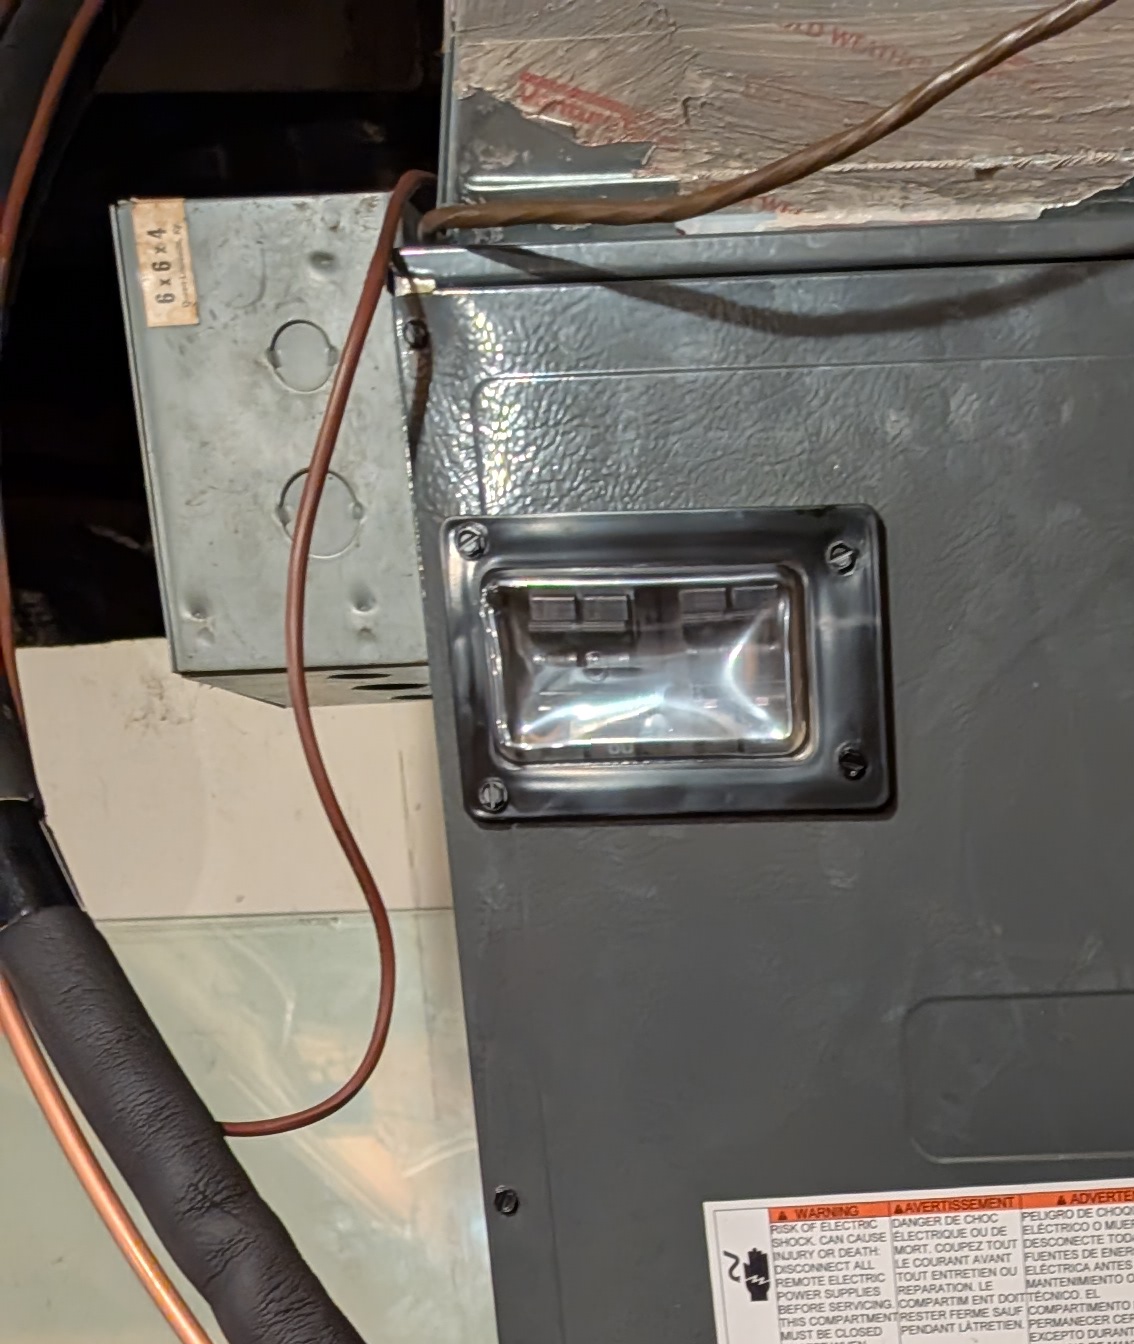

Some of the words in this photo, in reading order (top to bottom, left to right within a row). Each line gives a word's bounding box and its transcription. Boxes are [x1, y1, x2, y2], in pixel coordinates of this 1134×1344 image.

[147, 228, 167, 239] 4
[151, 261, 172, 272] 6
[155, 293, 176, 304] 6
[794, 1205, 860, 1218] WARNING
[904, 1197, 1016, 1213] AVERTISSEMENT
[769, 1224, 798, 1233] RISK
[800, 1223, 816, 1232] OF
[820, 1220, 877, 1231] ELECTRIC
[819, 1235, 844, 1245] CAN
[846, 1233, 886, 1243] CAUSE
[772, 1250, 815, 1260] INJURY
[817, 1249, 835, 1258] OR
[773, 1262, 850, 1273] DISCONNECT
[853, 1261, 875, 1271] ALL
[774, 1276, 825, 1287] REMOTE
[828, 1273, 885, 1284] ELECTRIC
[775, 1290, 821, 1300] POWER
[824, 1287, 880, 1298] SUPPLIES
[777, 1303, 825, 1314] BEFORE
[828, 1300, 892, 1311] SERVICING.
[778, 1317, 806, 1326] THIS
[808, 1312, 900, 1325] COMPARTMENT
[779, 1330, 813, 1340] MUST
[816, 1329, 832, 1338] BE
[834, 1327, 882, 1337] CLOSED
